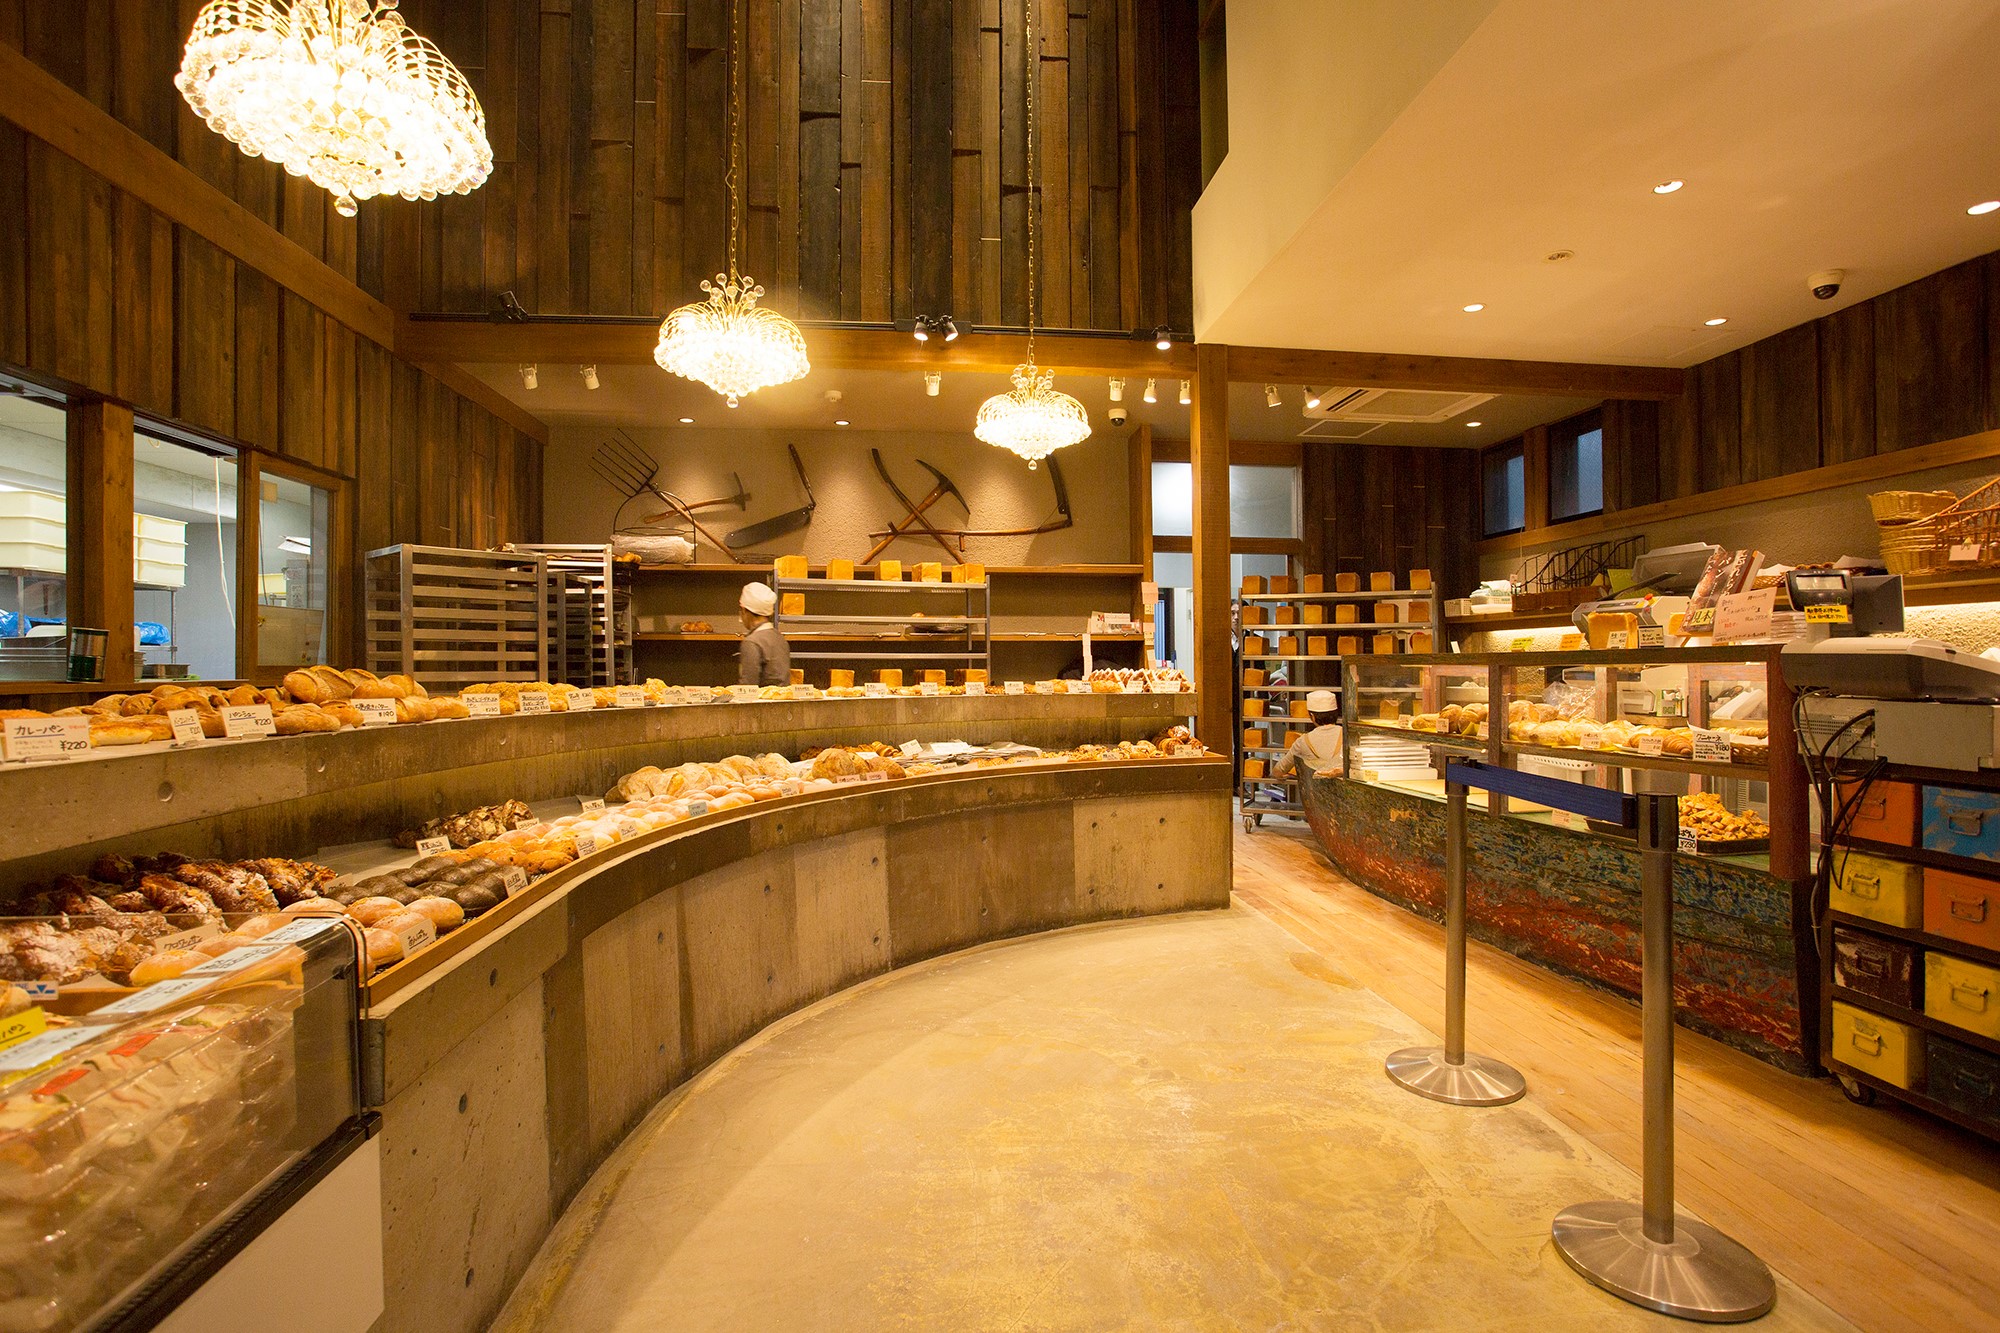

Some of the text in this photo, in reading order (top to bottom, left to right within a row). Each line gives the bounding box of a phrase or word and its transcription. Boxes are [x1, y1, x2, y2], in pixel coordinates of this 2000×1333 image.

[254, 718, 271, 726] ¥220
[14, 725, 64, 735] カレーパン
[60, 740, 88, 751] ¥220
